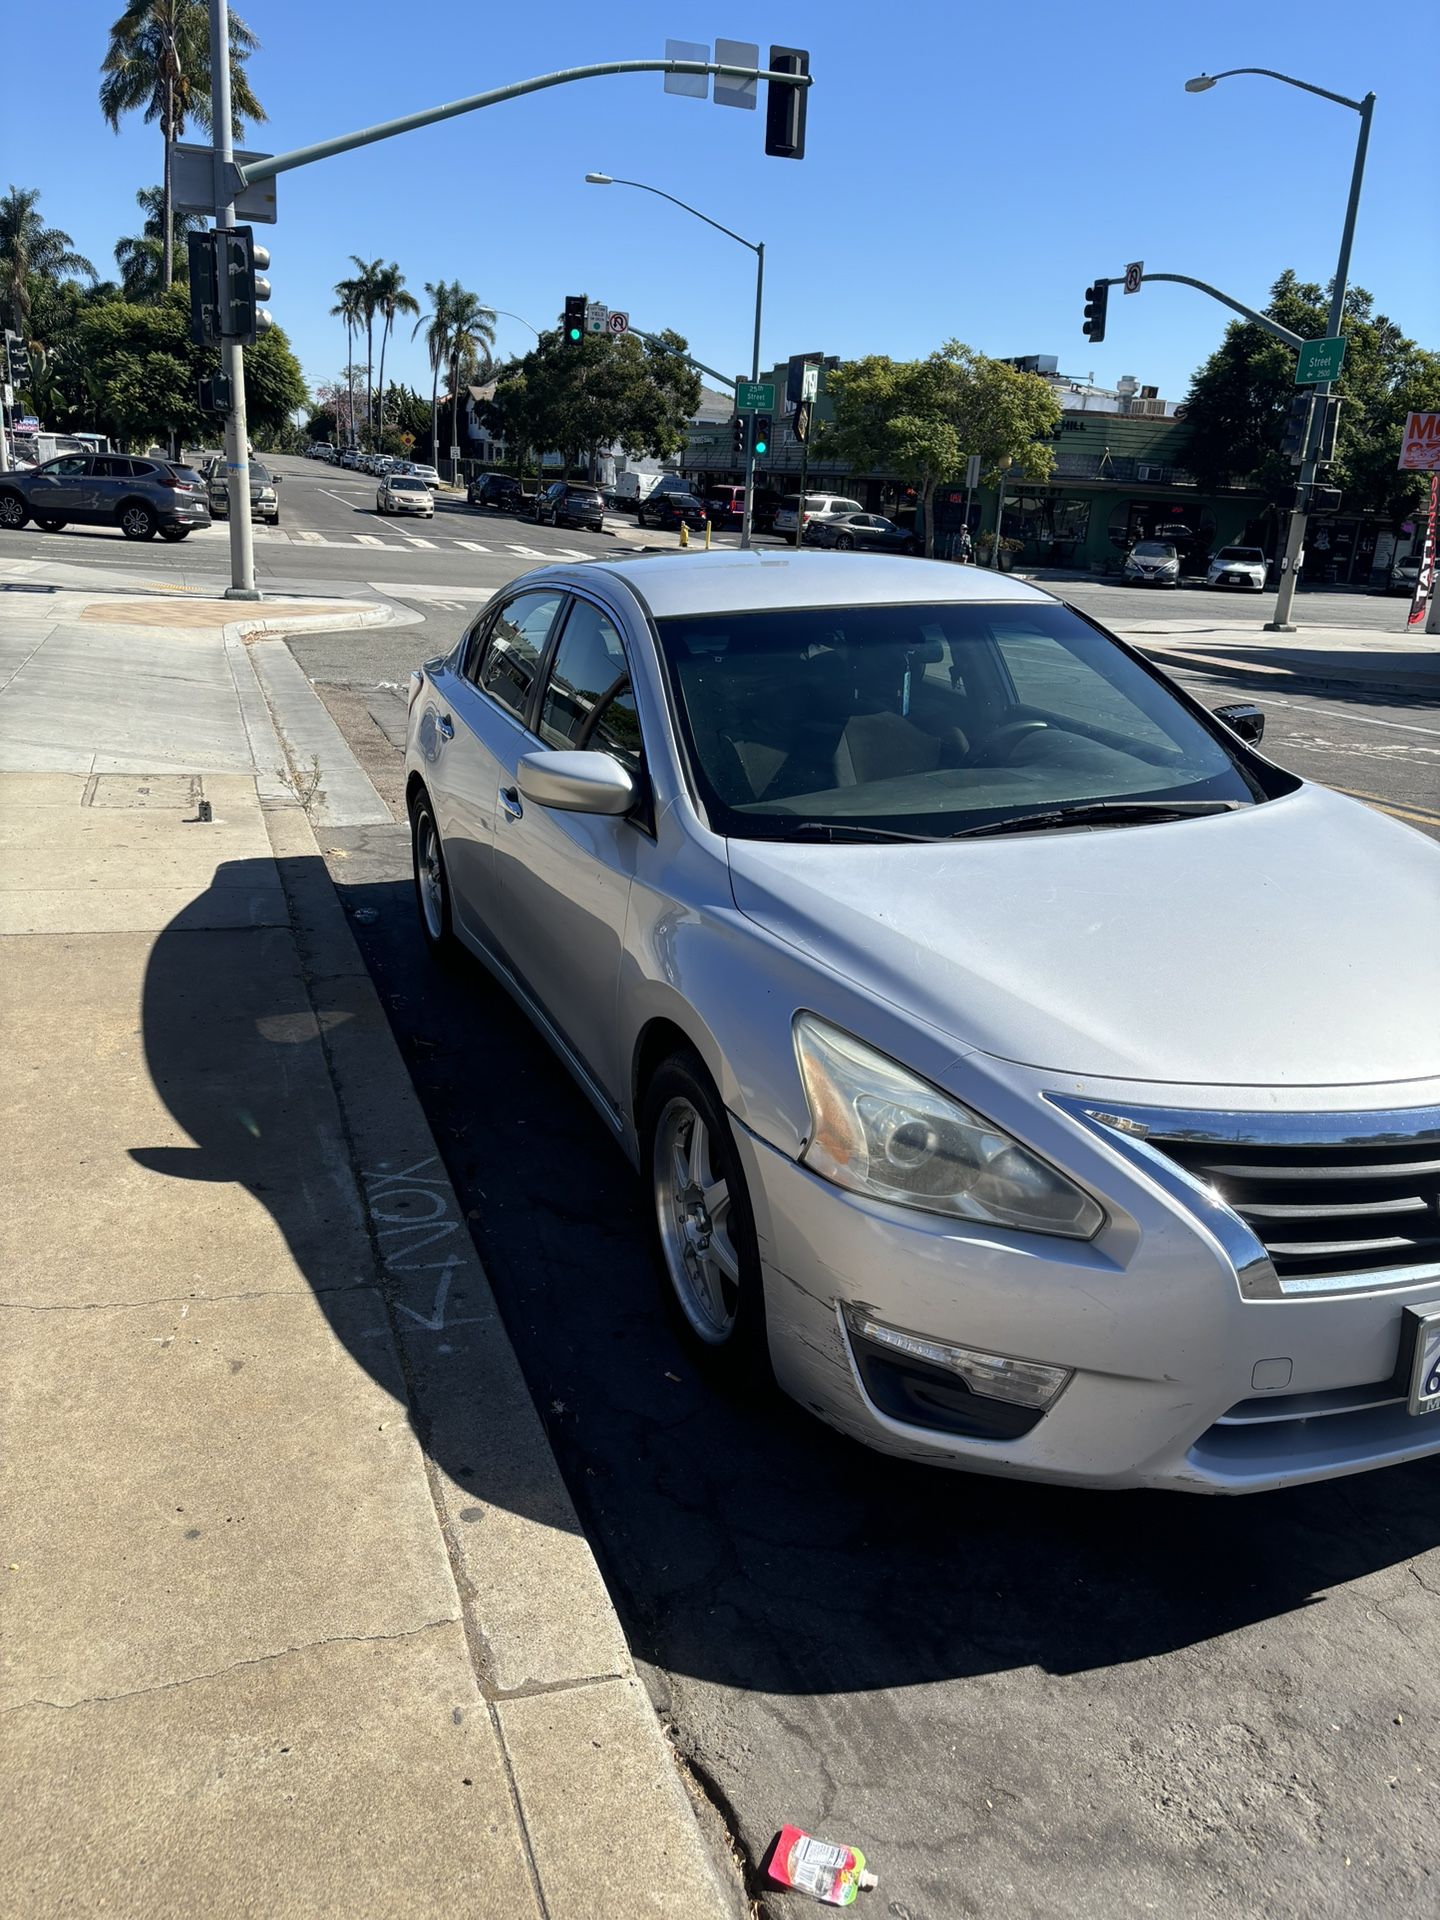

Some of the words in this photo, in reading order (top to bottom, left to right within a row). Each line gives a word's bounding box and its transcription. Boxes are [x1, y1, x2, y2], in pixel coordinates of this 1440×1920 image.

[1319, 343, 1325, 353] C
[1309, 356, 1331, 367] Street
[1062, 420, 1086, 431] HILL
[1408, 414, 1440, 440] M
